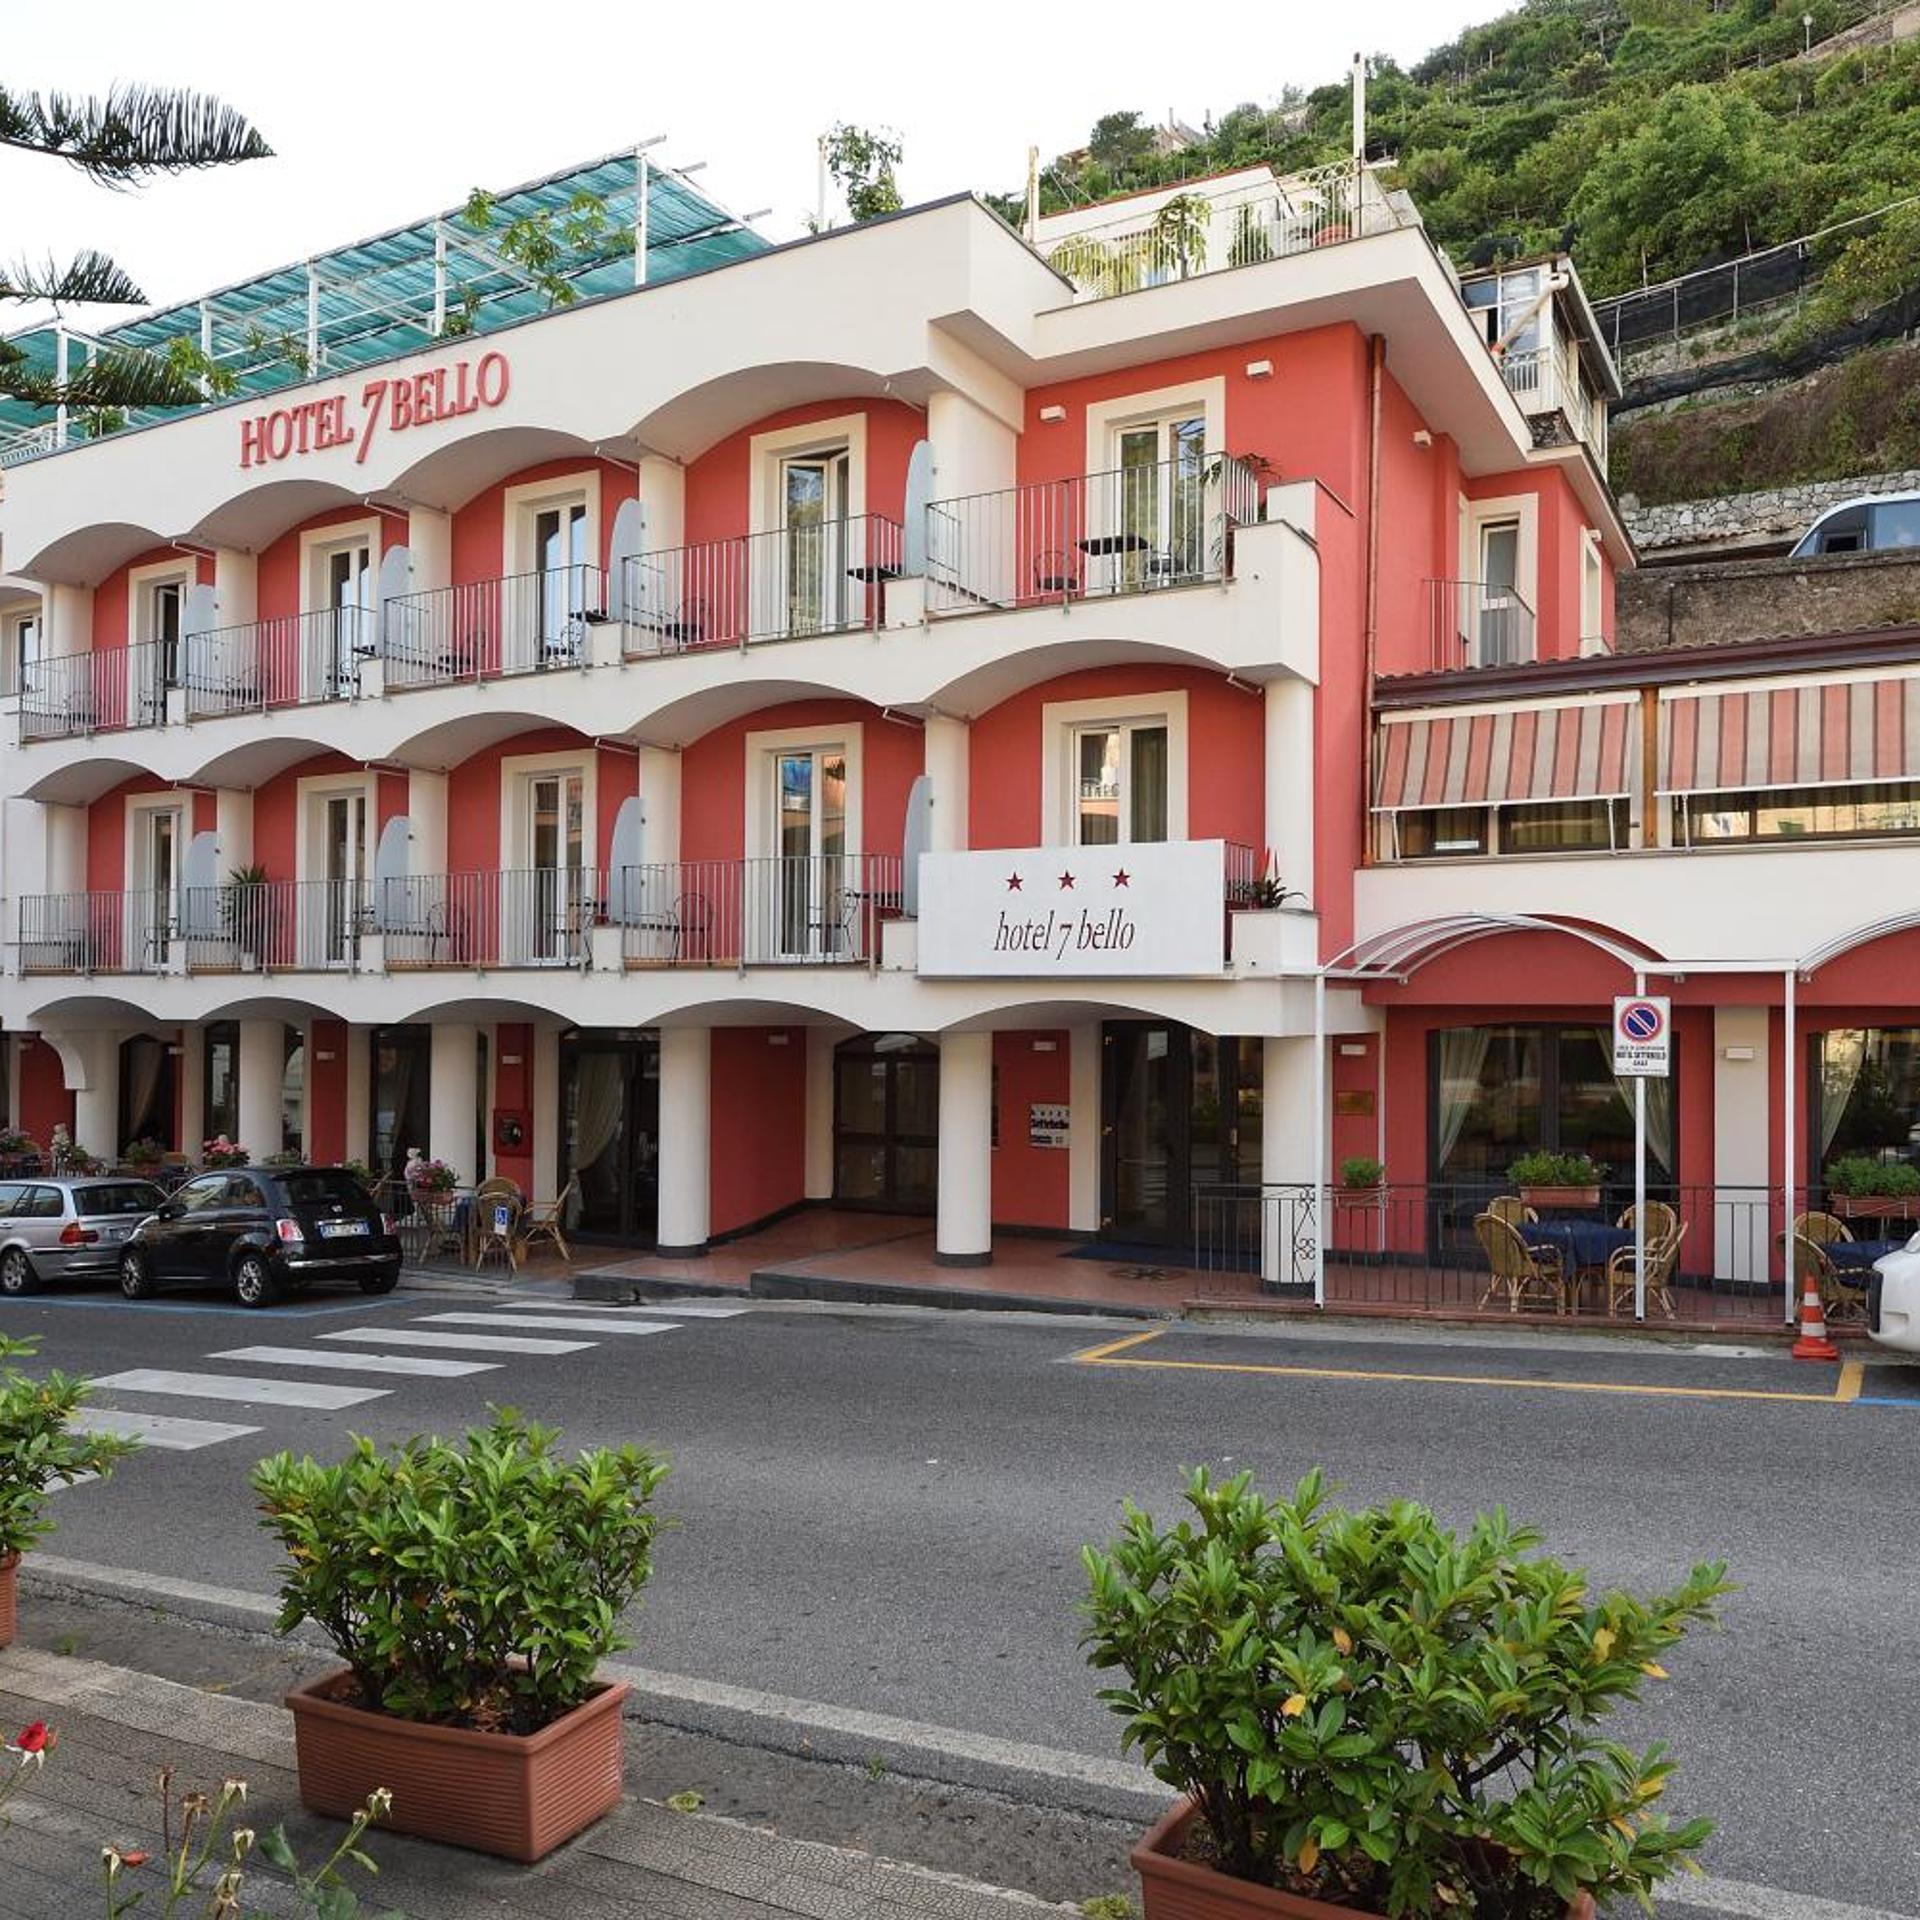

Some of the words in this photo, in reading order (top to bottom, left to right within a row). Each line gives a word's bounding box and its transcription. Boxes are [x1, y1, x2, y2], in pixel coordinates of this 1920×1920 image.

[240, 395, 354, 467] HOTEL
[356, 380, 388, 464] 7
[390, 351, 511, 431] BELLO
[994, 910, 1055, 951] hotel
[1056, 923, 1072, 960] 7
[1076, 908, 1135, 950] bello
